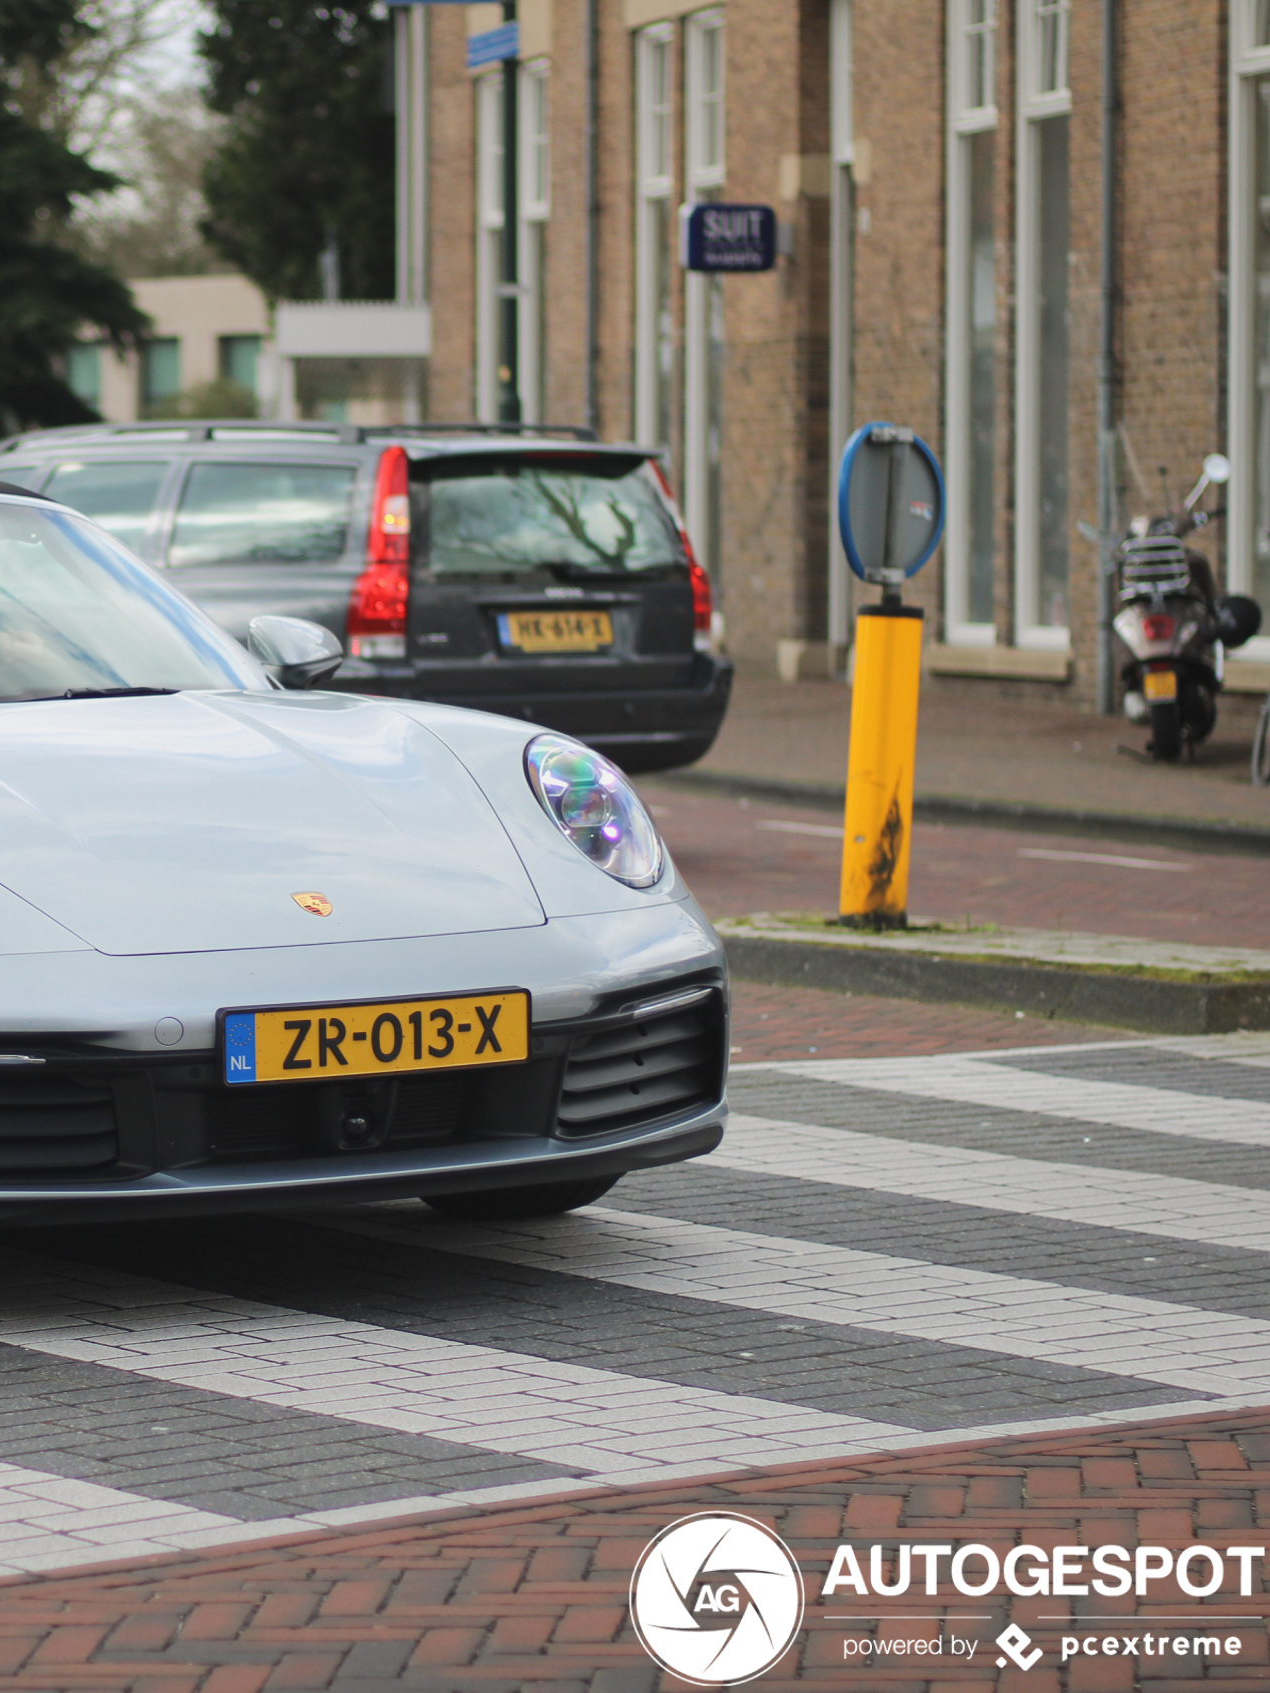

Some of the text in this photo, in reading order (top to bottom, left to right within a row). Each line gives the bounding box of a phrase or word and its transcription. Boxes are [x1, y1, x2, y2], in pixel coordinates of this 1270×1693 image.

[703, 209, 764, 240] SUIT
[282, 1004, 503, 1070] ZR-013-X
[230, 1055, 252, 1071] NL
